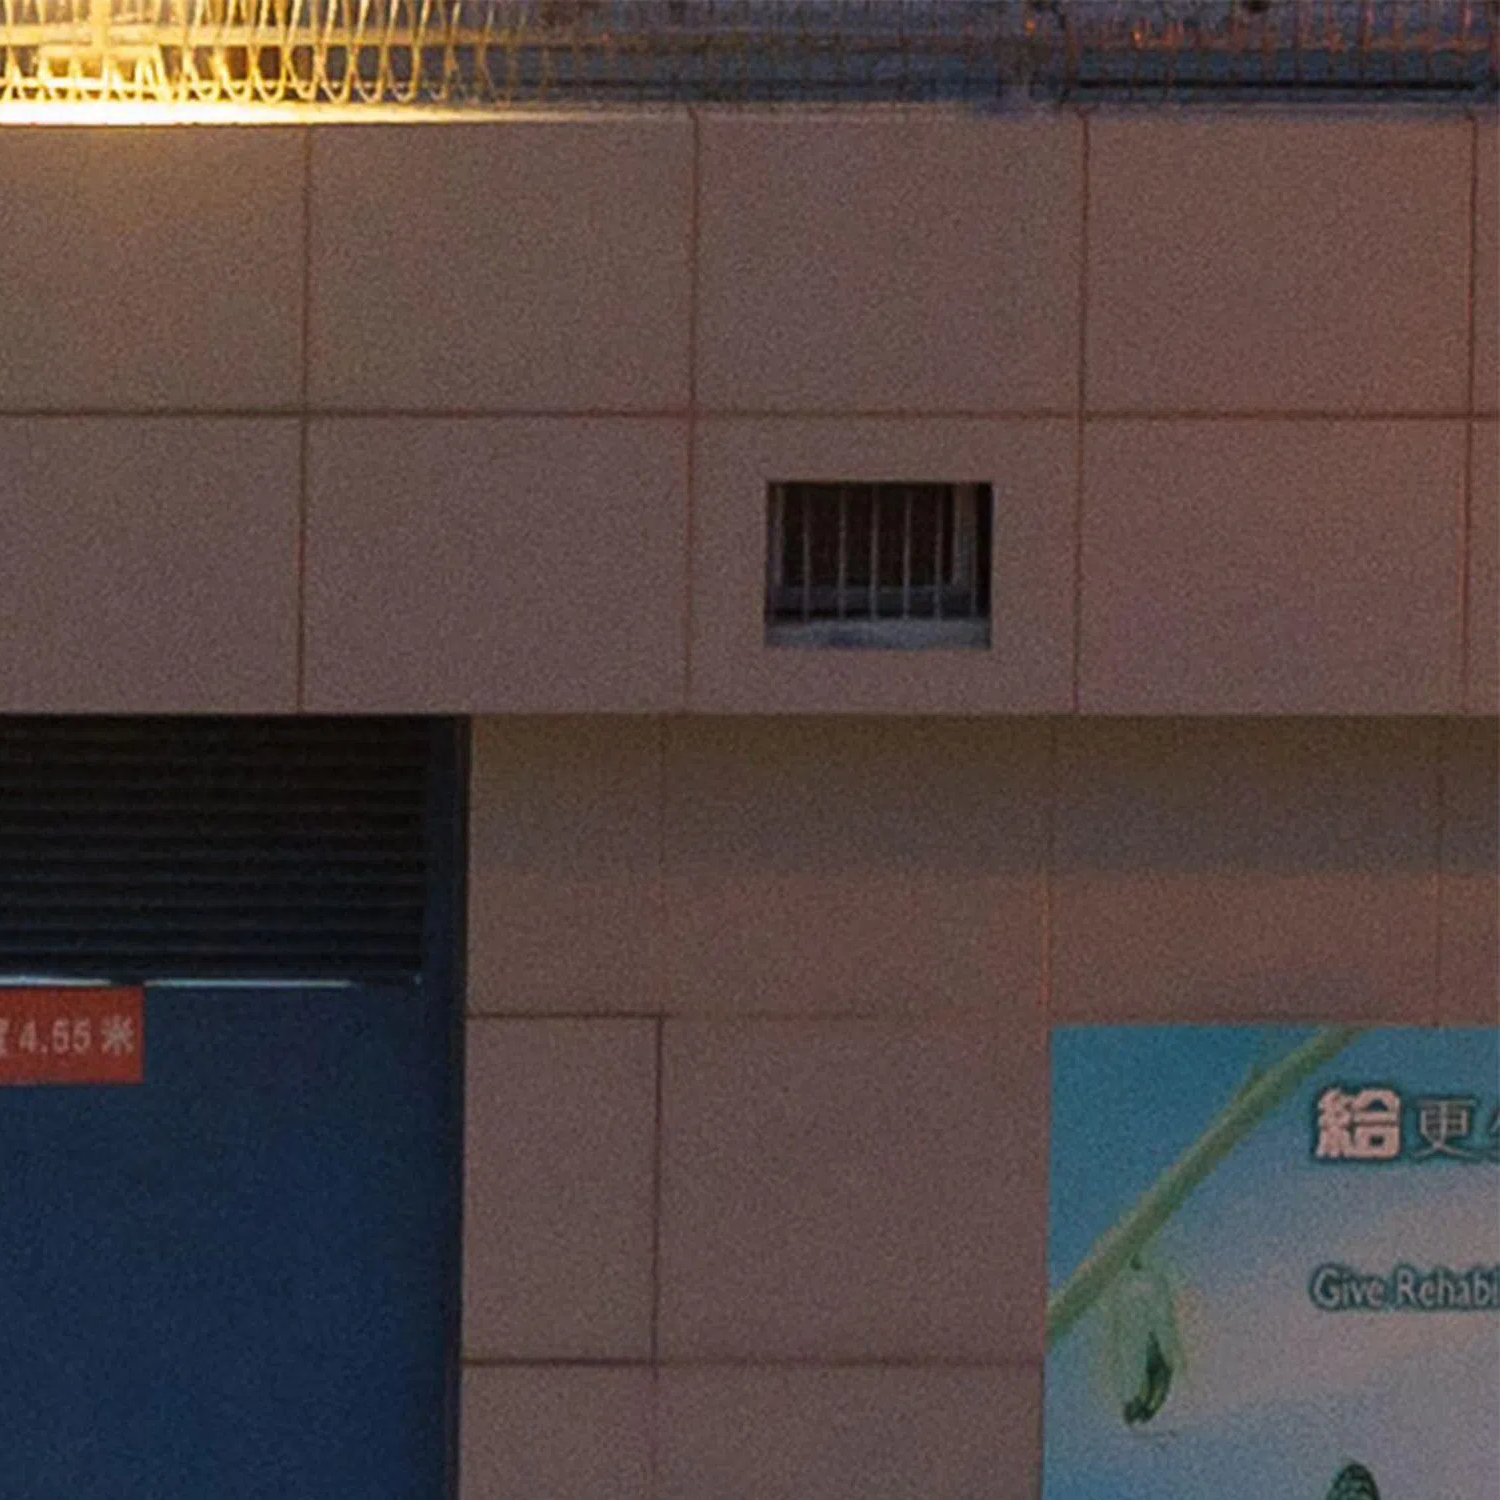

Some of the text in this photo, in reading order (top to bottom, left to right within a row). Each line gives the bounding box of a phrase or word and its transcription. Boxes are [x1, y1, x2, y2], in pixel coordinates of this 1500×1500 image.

[17, 1018, 92, 1054] 4.55
[1314, 1086, 1500, 1161] 給更
[1312, 1267, 1386, 1308] Give
